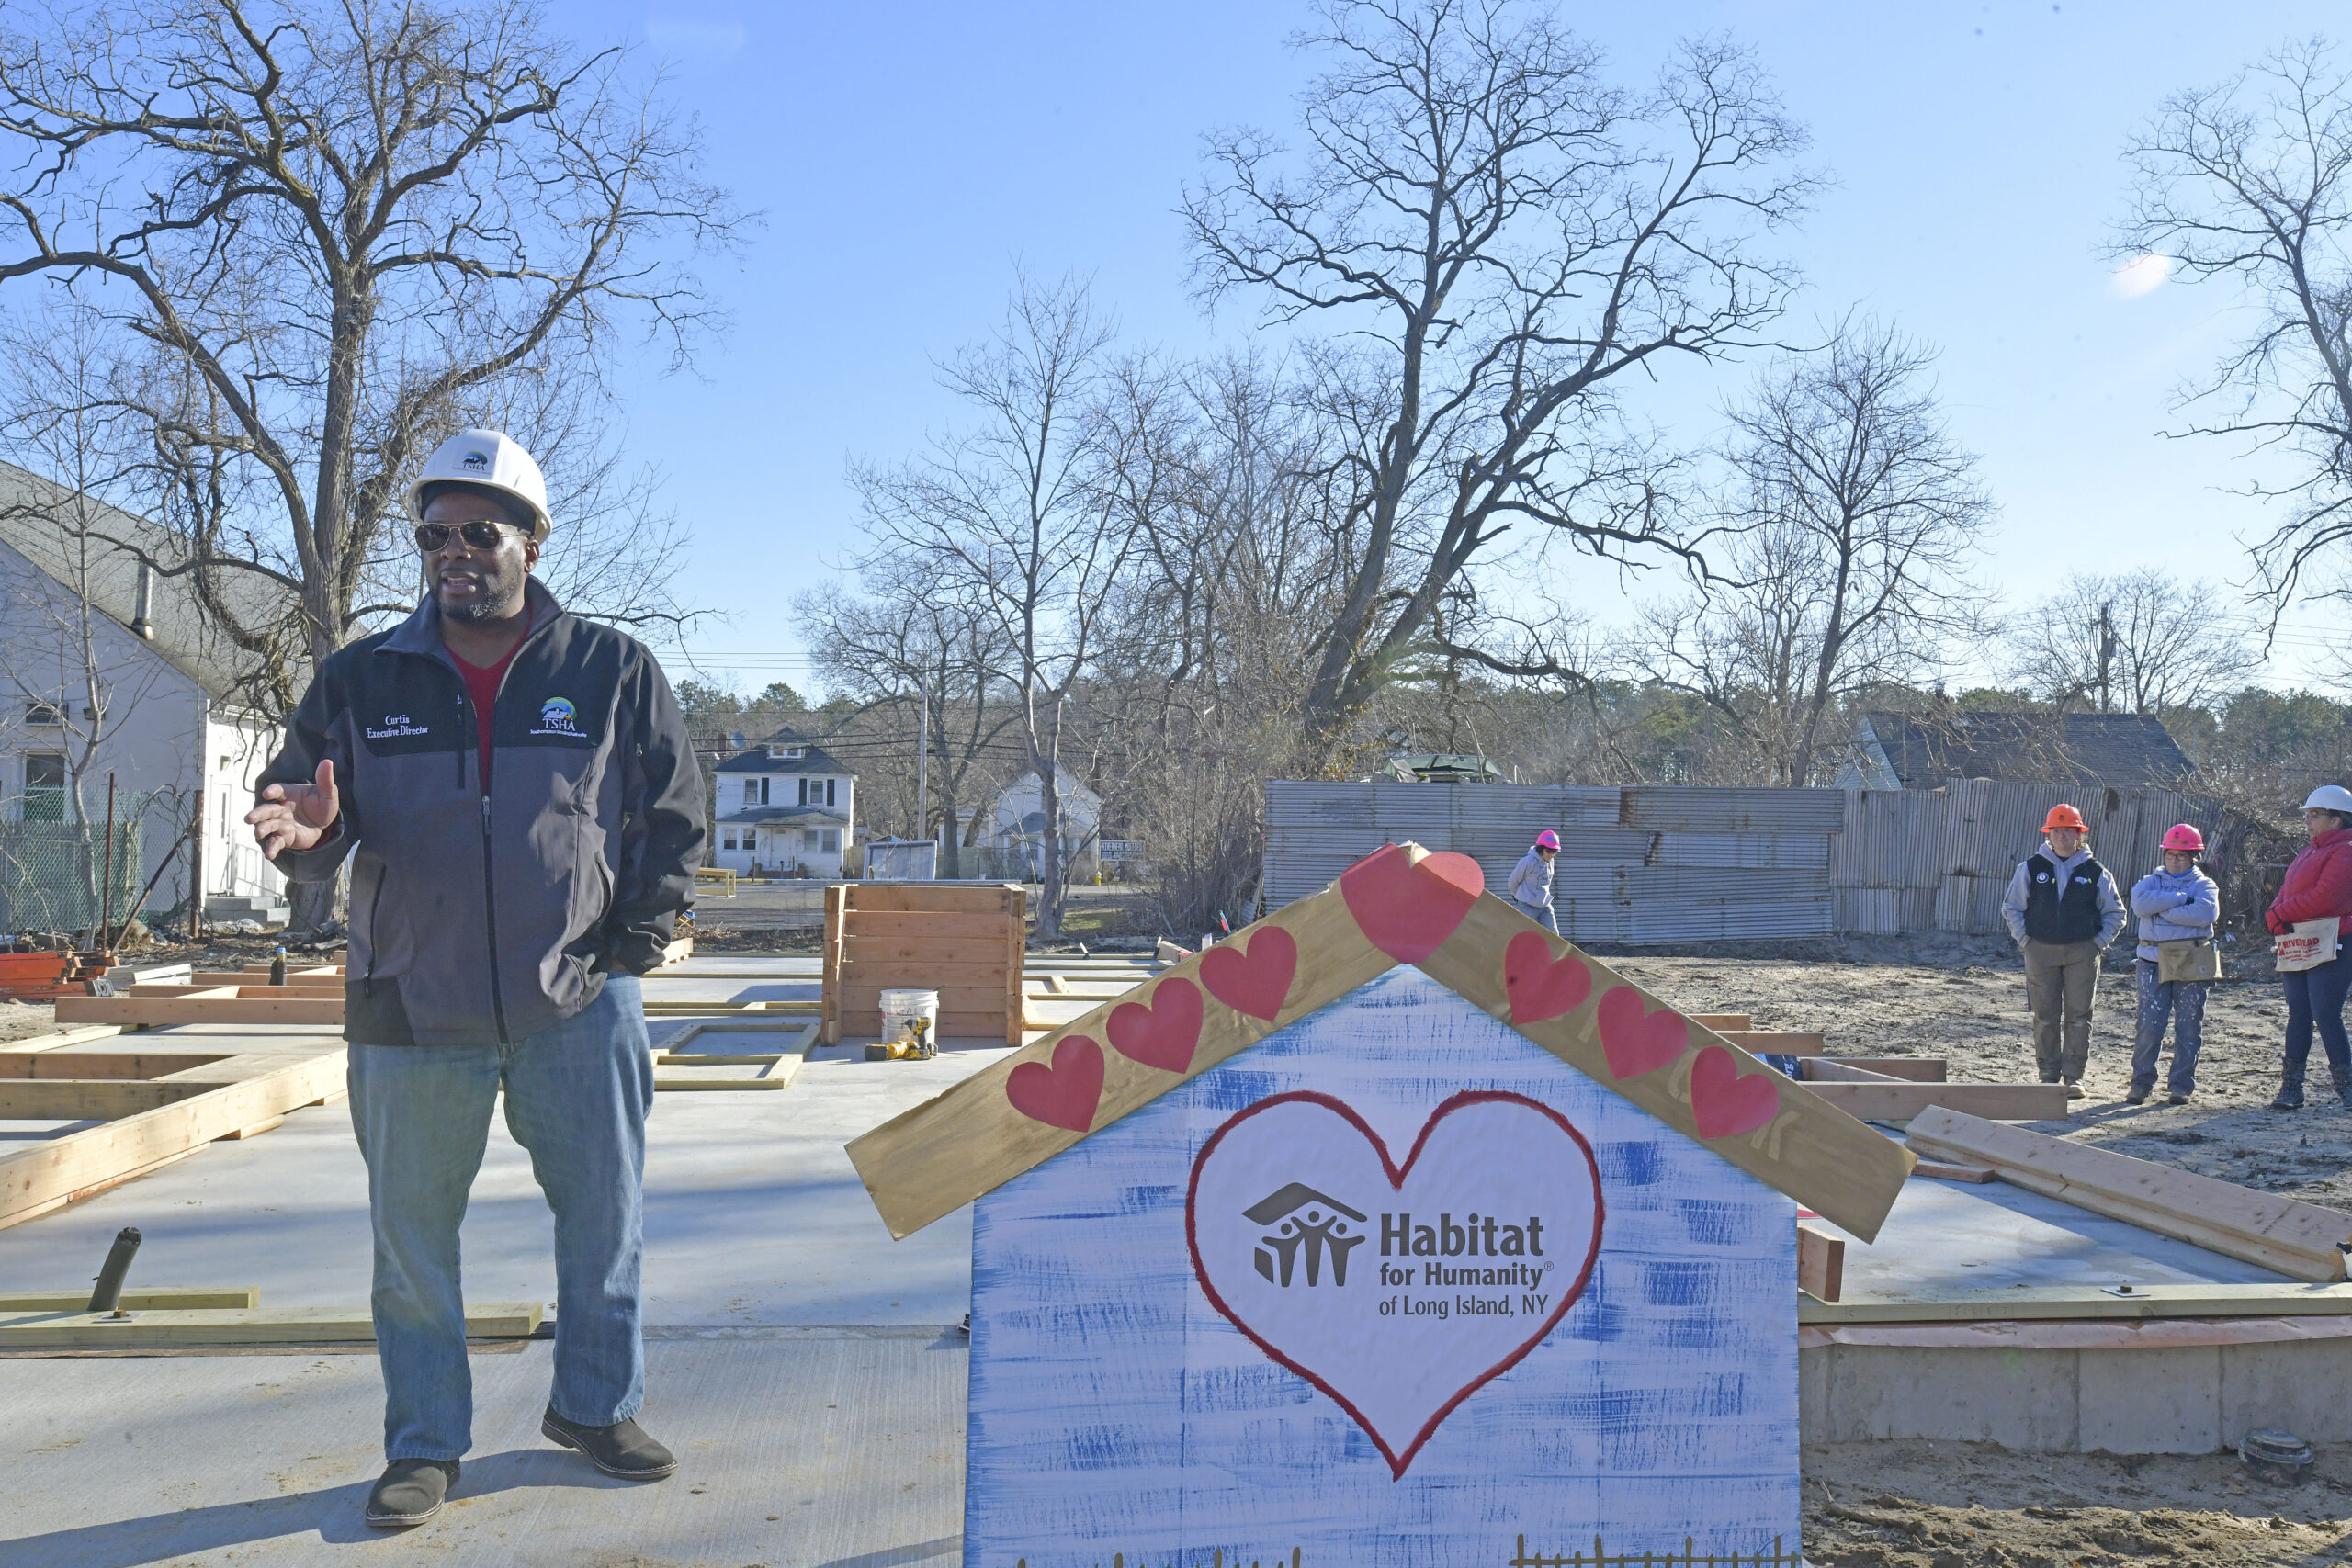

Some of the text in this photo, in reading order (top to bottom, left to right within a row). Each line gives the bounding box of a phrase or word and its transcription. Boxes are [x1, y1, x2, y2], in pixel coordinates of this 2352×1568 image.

[462, 462, 485, 471] TSHA
[385, 715, 410, 725] Curtis
[542, 718, 576, 731] TSHA
[367, 725, 429, 739] Executive Director
[2282, 937, 2320, 949] RIVEEAD
[1380, 1213, 1544, 1257] Habitat
[1380, 1262, 1416, 1286] for
[1379, 1294, 1549, 1320] of Long Island, NY
